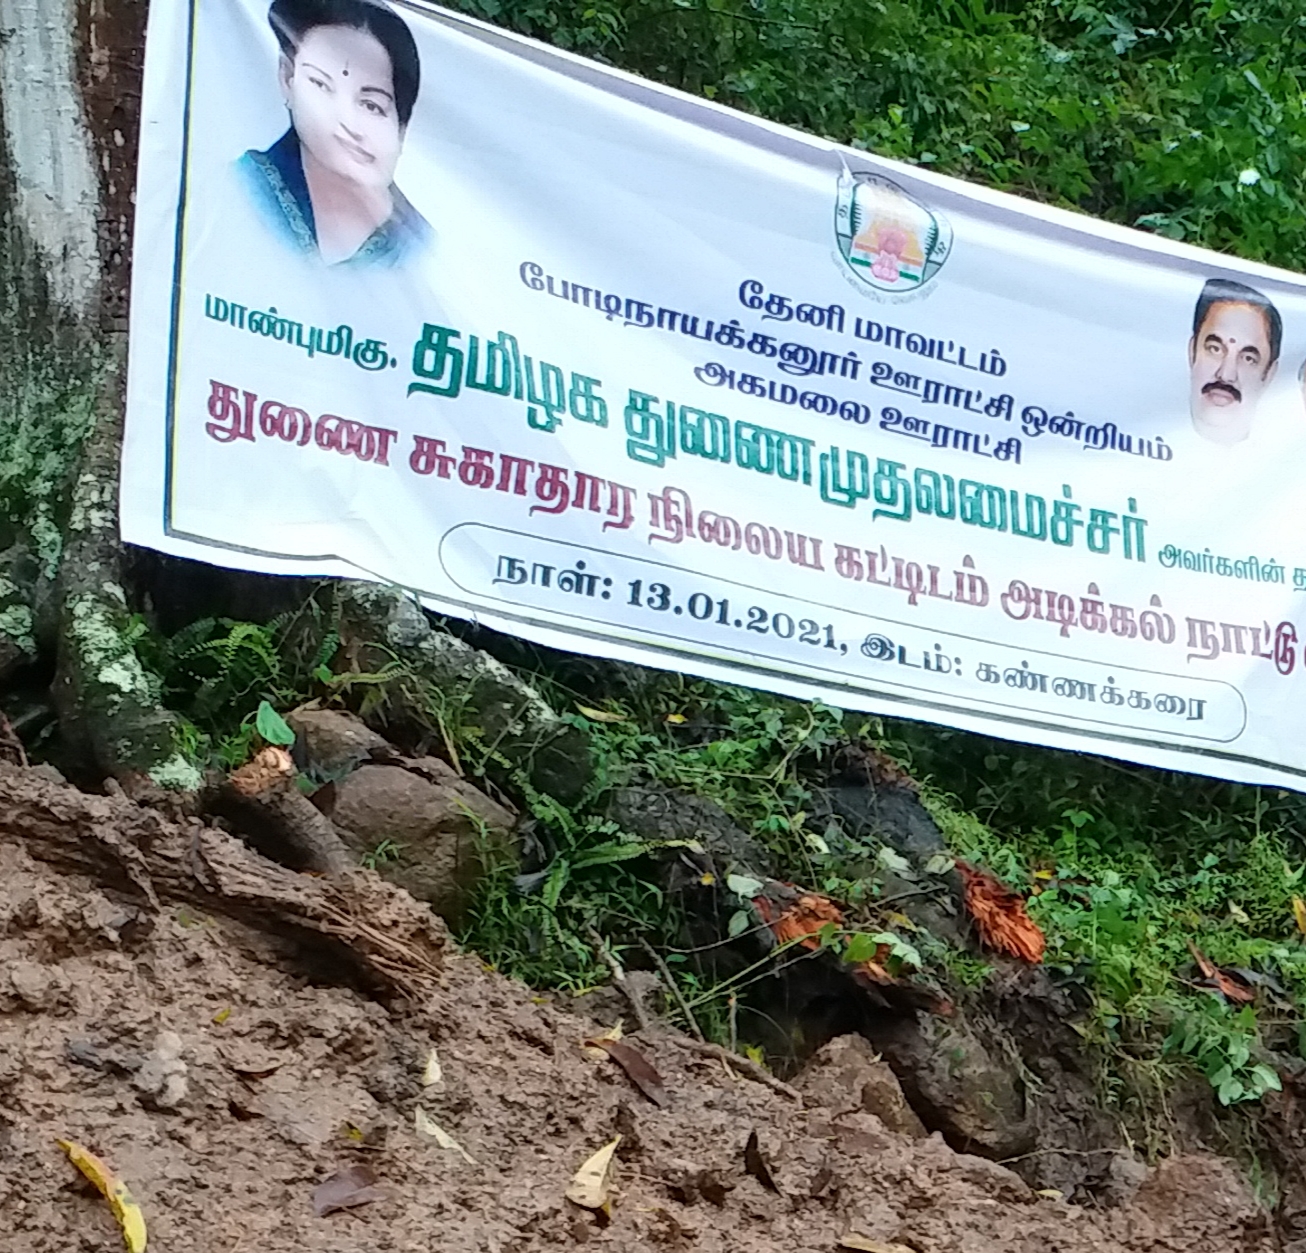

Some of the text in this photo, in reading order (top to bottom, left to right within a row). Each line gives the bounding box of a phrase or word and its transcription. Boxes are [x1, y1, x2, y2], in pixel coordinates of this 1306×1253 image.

[519, 261, 863, 380] போடிநாயக்கனூர்
[870, 361, 1015, 422] ஊராட்சி
[1021, 405, 1173, 462] ஒன்றியம்
[693, 362, 1022, 465] அகமலை ஊராட்சி
[739, 279, 845, 333] தேனி
[854, 316, 1007, 377] மாவட்டம்
[204, 293, 397, 371] மாண்புமிகு.
[407, 322, 609, 433] தமிழக
[1158, 544, 1286, 584] அவர்களின்
[205, 378, 399, 467] துணை
[409, 433, 638, 533] சுகாதார
[647, 486, 825, 572] நிலைய
[834, 544, 990, 607] கட்டிடம்
[1000, 579, 1176, 644] அடிக்கல்
[1185, 620, 1298, 676] நாட்டு
[492, 555, 1207, 721] நாள்: 13.01.2021, இடம்: கண்ணக்கரை
